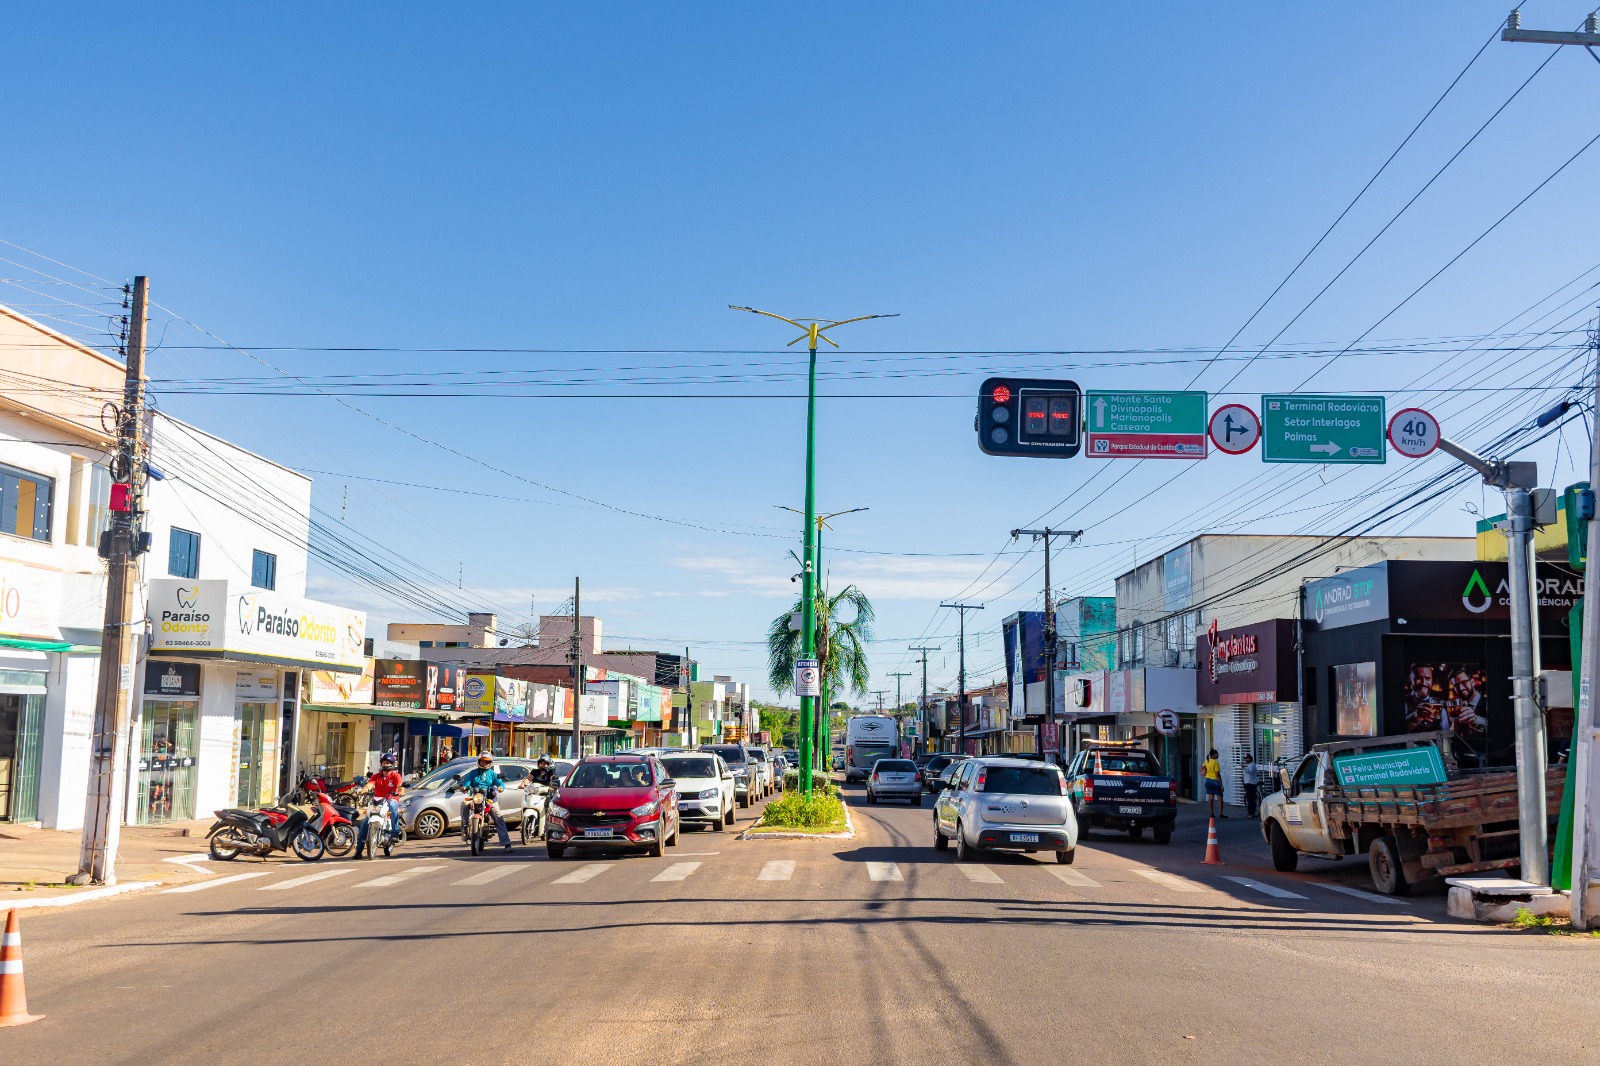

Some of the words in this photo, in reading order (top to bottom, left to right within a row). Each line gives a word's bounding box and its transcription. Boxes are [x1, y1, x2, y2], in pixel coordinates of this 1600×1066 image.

[1111, 395, 1141, 404] Monte
[1144, 395, 1172, 404] Santo
[1110, 404, 1162, 414] Divinópolis
[1284, 401, 1325, 411] Terminal
[1328, 402, 1379, 412] Rodoviário
[1110, 414, 1172, 424] Marianópolis
[1284, 417, 1310, 426] Setor
[1312, 417, 1361, 429] Interlagos
[1110, 422, 1150, 431] Caseara
[1402, 420, 1426, 436] 40
[1284, 432, 1317, 442] Palmas
[1402, 436, 1426, 446] km/h
[1111, 443, 1128, 451] Parque
[1496, 578, 1585, 595] ADRAD
[1324, 585, 1352, 606] ANDRAD
[1354, 580, 1373, 598] STOP
[162, 610, 210, 622] Paraíso
[162, 622, 209, 632] Odonto
[1162, 714, 1173, 730] E
[229, 726, 239, 802] SORRIA
[1353, 764, 1372, 773] Feira
[1373, 759, 1410, 770] Municipal
[1355, 772, 1388, 782] Terminal
[1390, 766, 1430, 778] Rodoviário
